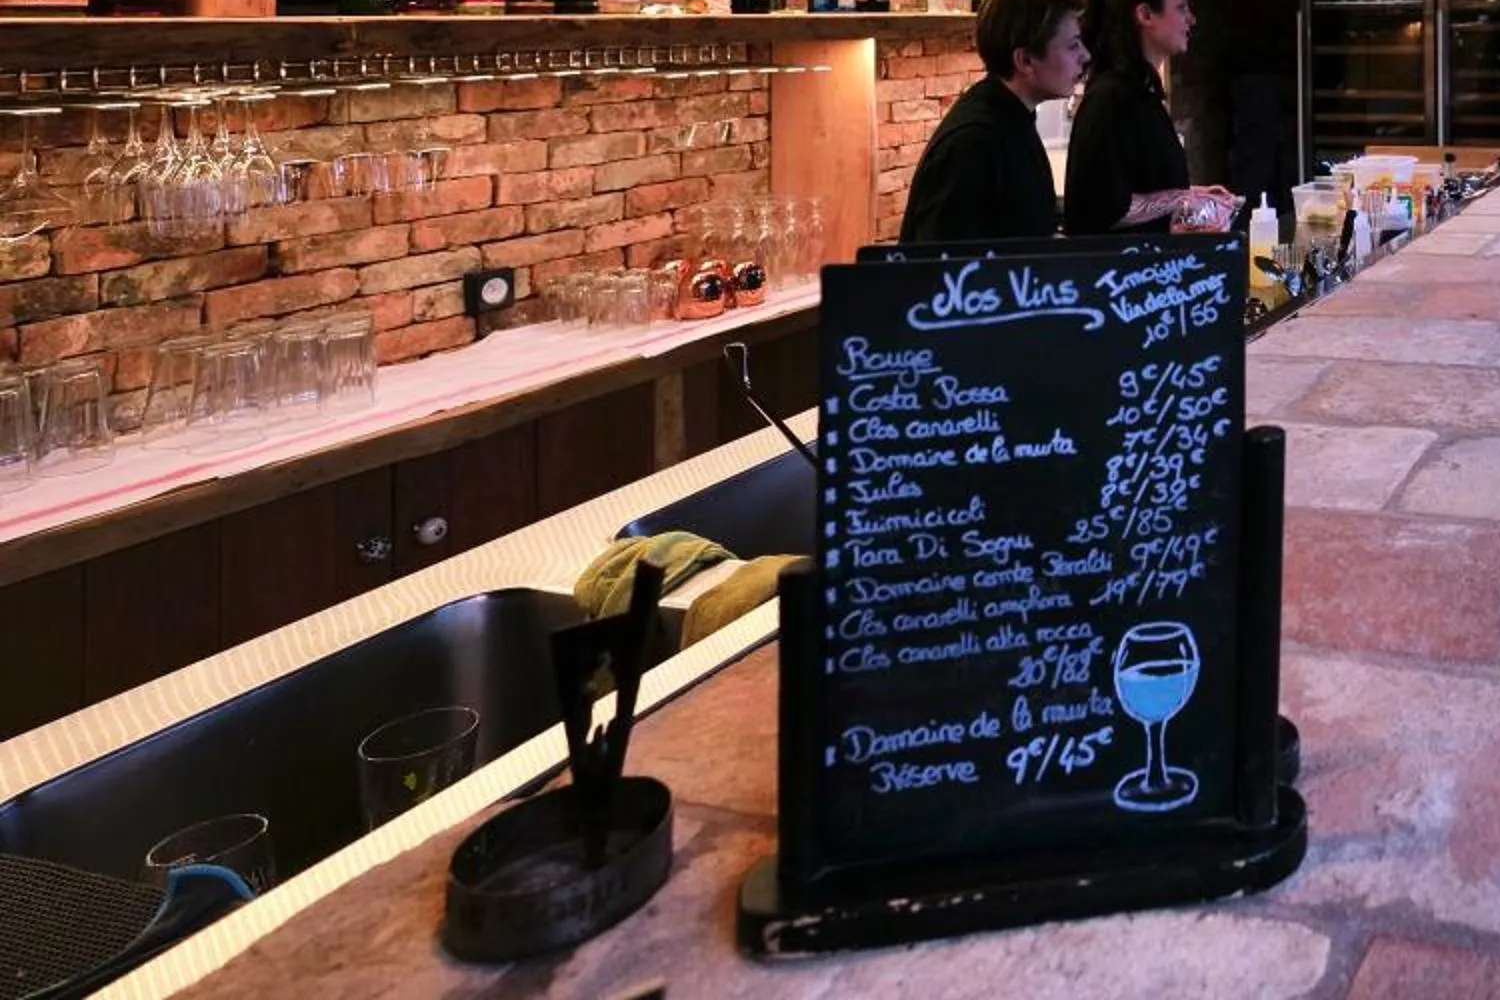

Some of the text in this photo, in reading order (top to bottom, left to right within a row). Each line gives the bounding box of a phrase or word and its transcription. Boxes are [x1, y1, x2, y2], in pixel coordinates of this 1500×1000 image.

[932, 261, 1079, 317] Nos Vins
[836, 336, 934, 388] Rouge
[848, 383, 922, 412] Costa
[932, 375, 1009, 409] Rossa
[848, 416, 899, 443] Clos
[905, 409, 1001, 440] canarelli
[848, 448, 959, 475] Domaine
[965, 443, 989, 464] de
[991, 435, 1012, 464] la
[847, 472, 923, 504] Jules
[844, 536, 903, 567] Tara
[908, 532, 949, 559] Di
[846, 576, 966, 605] Domaine
[972, 560, 1034, 587] comte
[839, 608, 888, 640] Clos
[893, 597, 979, 631] canarelli
[839, 643, 892, 672] Clos
[897, 631, 982, 664] canarelli
[985, 624, 1029, 650] alta
[842, 720, 964, 763] Domaine
[970, 712, 1001, 738] de
[1012, 695, 1032, 732] la
